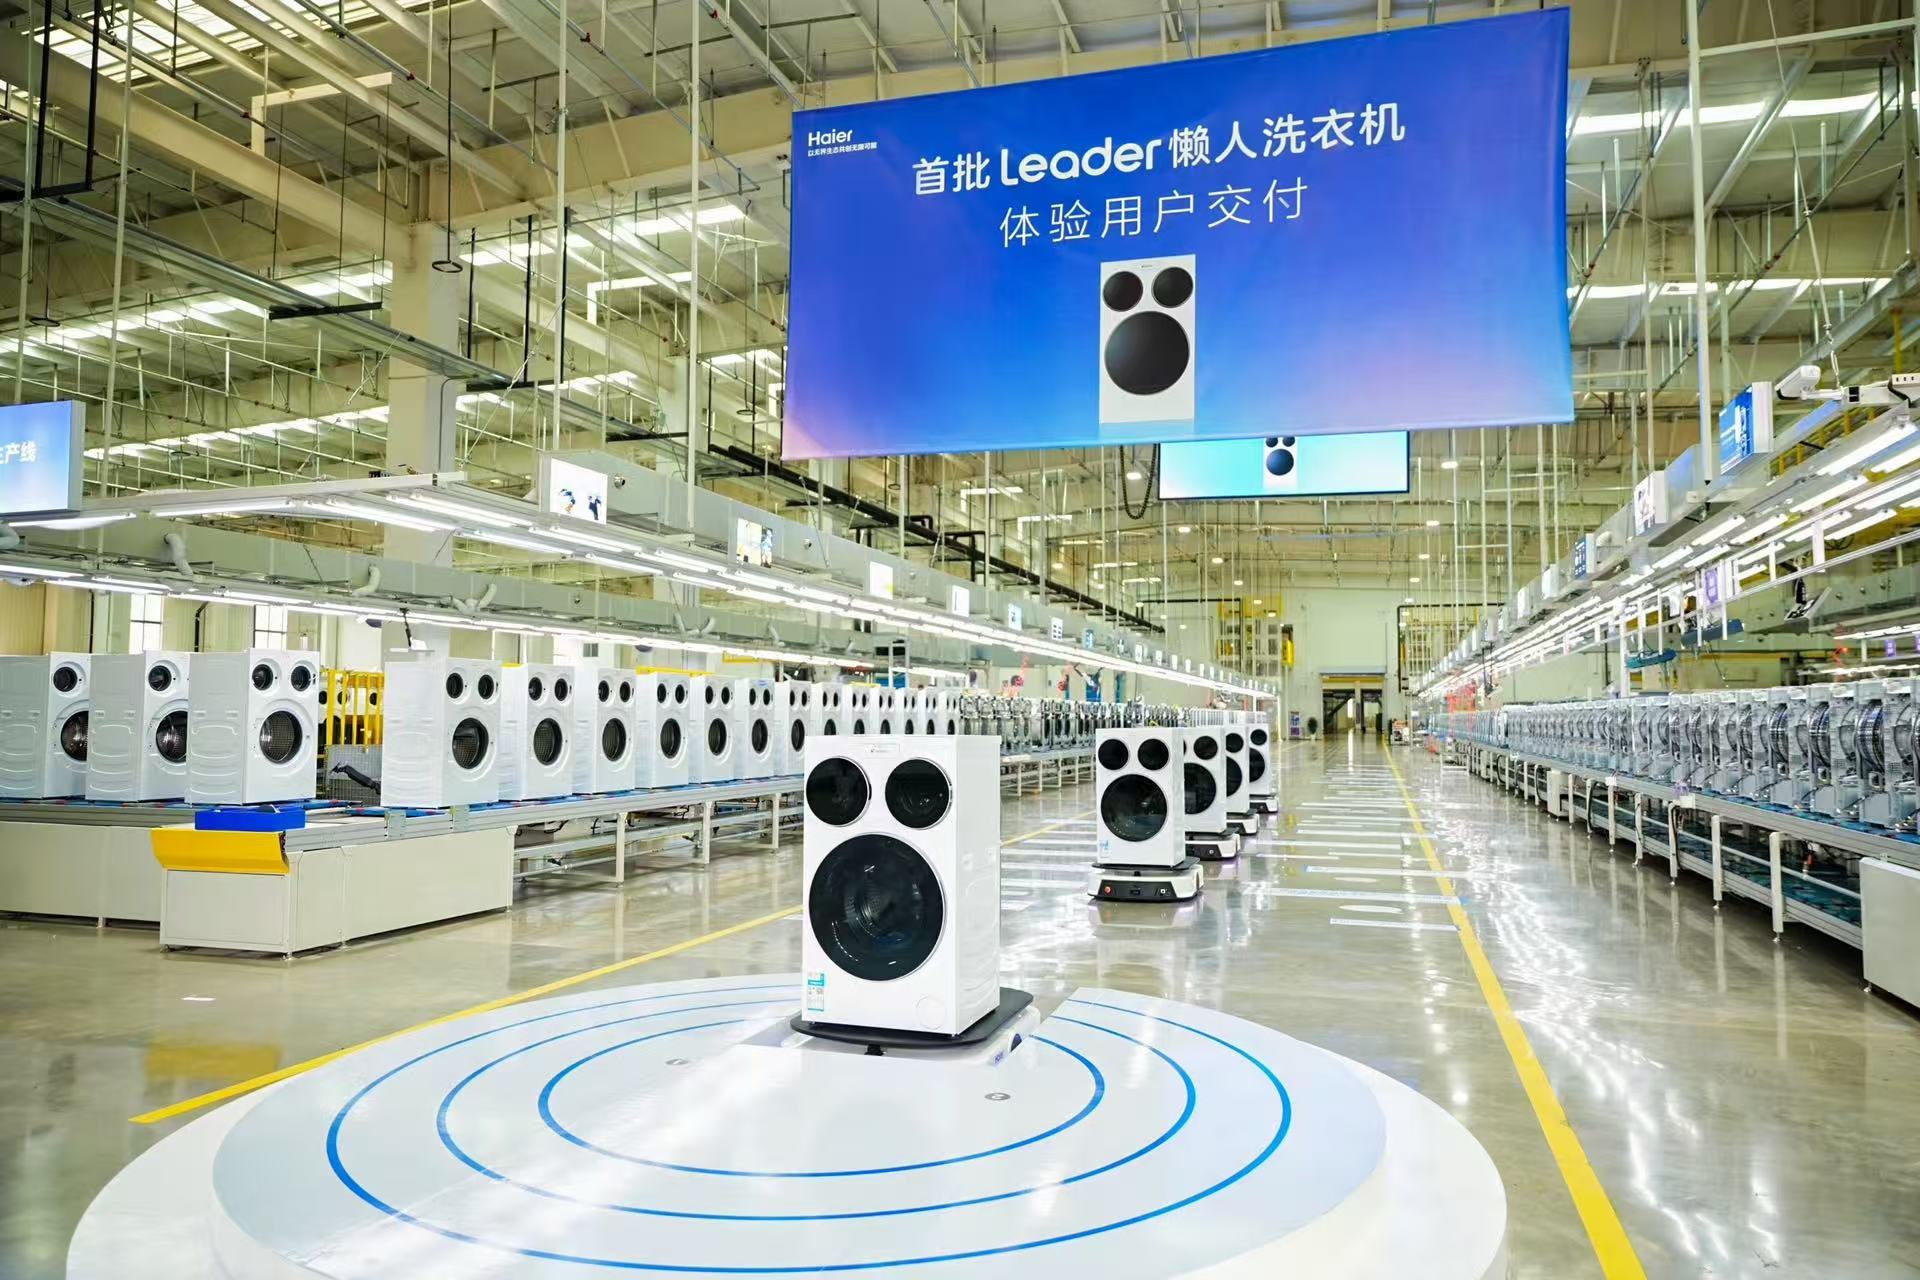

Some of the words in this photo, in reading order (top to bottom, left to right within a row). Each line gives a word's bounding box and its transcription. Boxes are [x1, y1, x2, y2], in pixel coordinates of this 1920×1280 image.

[808, 128, 853, 147] Haier
[912, 151, 991, 195] 首批
[1000, 136, 1162, 186] Leader
[1168, 102, 1406, 169] 懒人洗衣机
[999, 176, 1308, 248] 体验用户交付
[0, 440, 37, 464] 产线
